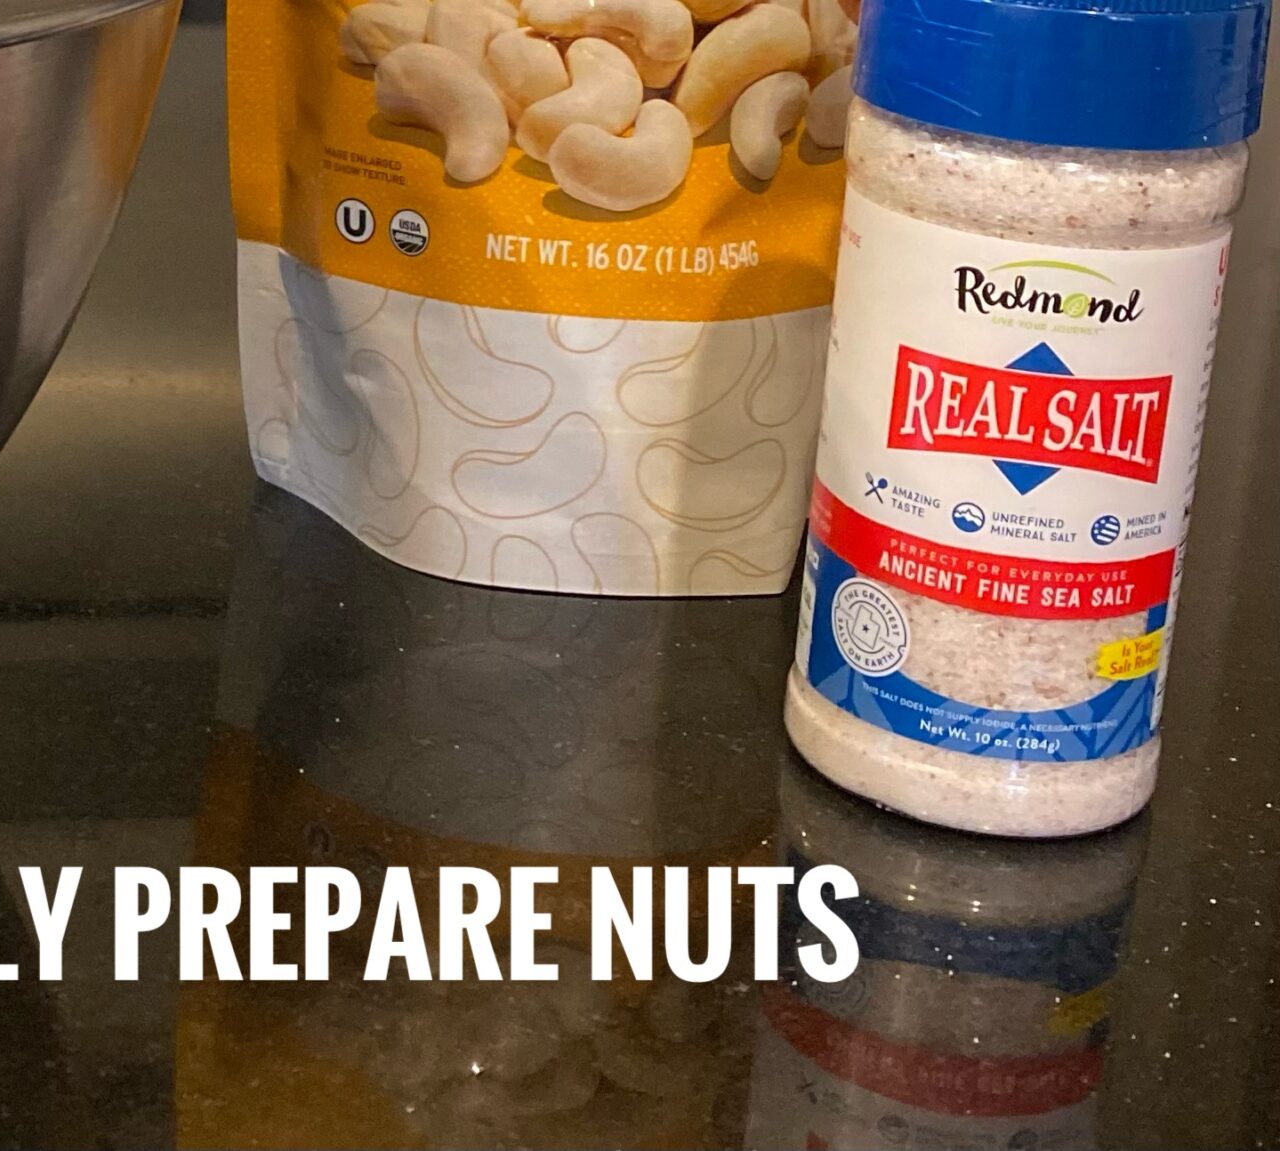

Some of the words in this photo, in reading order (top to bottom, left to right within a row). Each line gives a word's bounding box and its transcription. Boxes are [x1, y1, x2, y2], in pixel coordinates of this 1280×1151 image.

[362, 168, 406, 186] TEXTURE
[398, 219, 422, 234] USDA
[485, 233, 532, 263] NET
[538, 238, 579, 268] WT.
[586, 242, 610, 270] 16
[616, 244, 648, 272] OZ
[655, 246, 674, 276] (1
[680, 246, 716, 276] LB)
[718, 239, 759, 270] 454G
[954, 265, 1145, 324] Redmond
[891, 497, 926, 518] TASTE
[892, 485, 941, 509] AMAZING
[992, 511, 1065, 529] UNREFINED
[1124, 525, 1162, 541] AMERICA
[1126, 512, 1155, 527] MINED
[1157, 510, 1167, 521] IN
[990, 525, 1045, 541] MINERAL
[1050, 531, 1078, 543] SALT
[890, 538, 959, 567] PERFECT
[966, 560, 1000, 575] FOR
[1009, 567, 1095, 583] EVERYDAY
[1101, 570, 1128, 583] USE
[879, 550, 968, 594] ANCIENT
[977, 578, 1031, 605] FINE
[1041, 586, 1081, 608] SEA
[1091, 583, 1135, 608] SALT
[844, 589, 860, 602] THE
[862, 590, 900, 636] GREATEST
[837, 617, 849, 645] SALT
[848, 647, 862, 662] ON
[865, 651, 895, 667] EARTH
[880, 689, 898, 702] SALT
[900, 697, 924, 712] DOES
[926, 705, 945, 718] NOT
[947, 711, 980, 725] SUPPLY
[920, 718, 944, 736] Net
[948, 725, 971, 742] Wt.
[975, 732, 991, 745] 10
[994, 737, 1013, 748] oz.
[1016, 736, 1060, 754] (284g)
